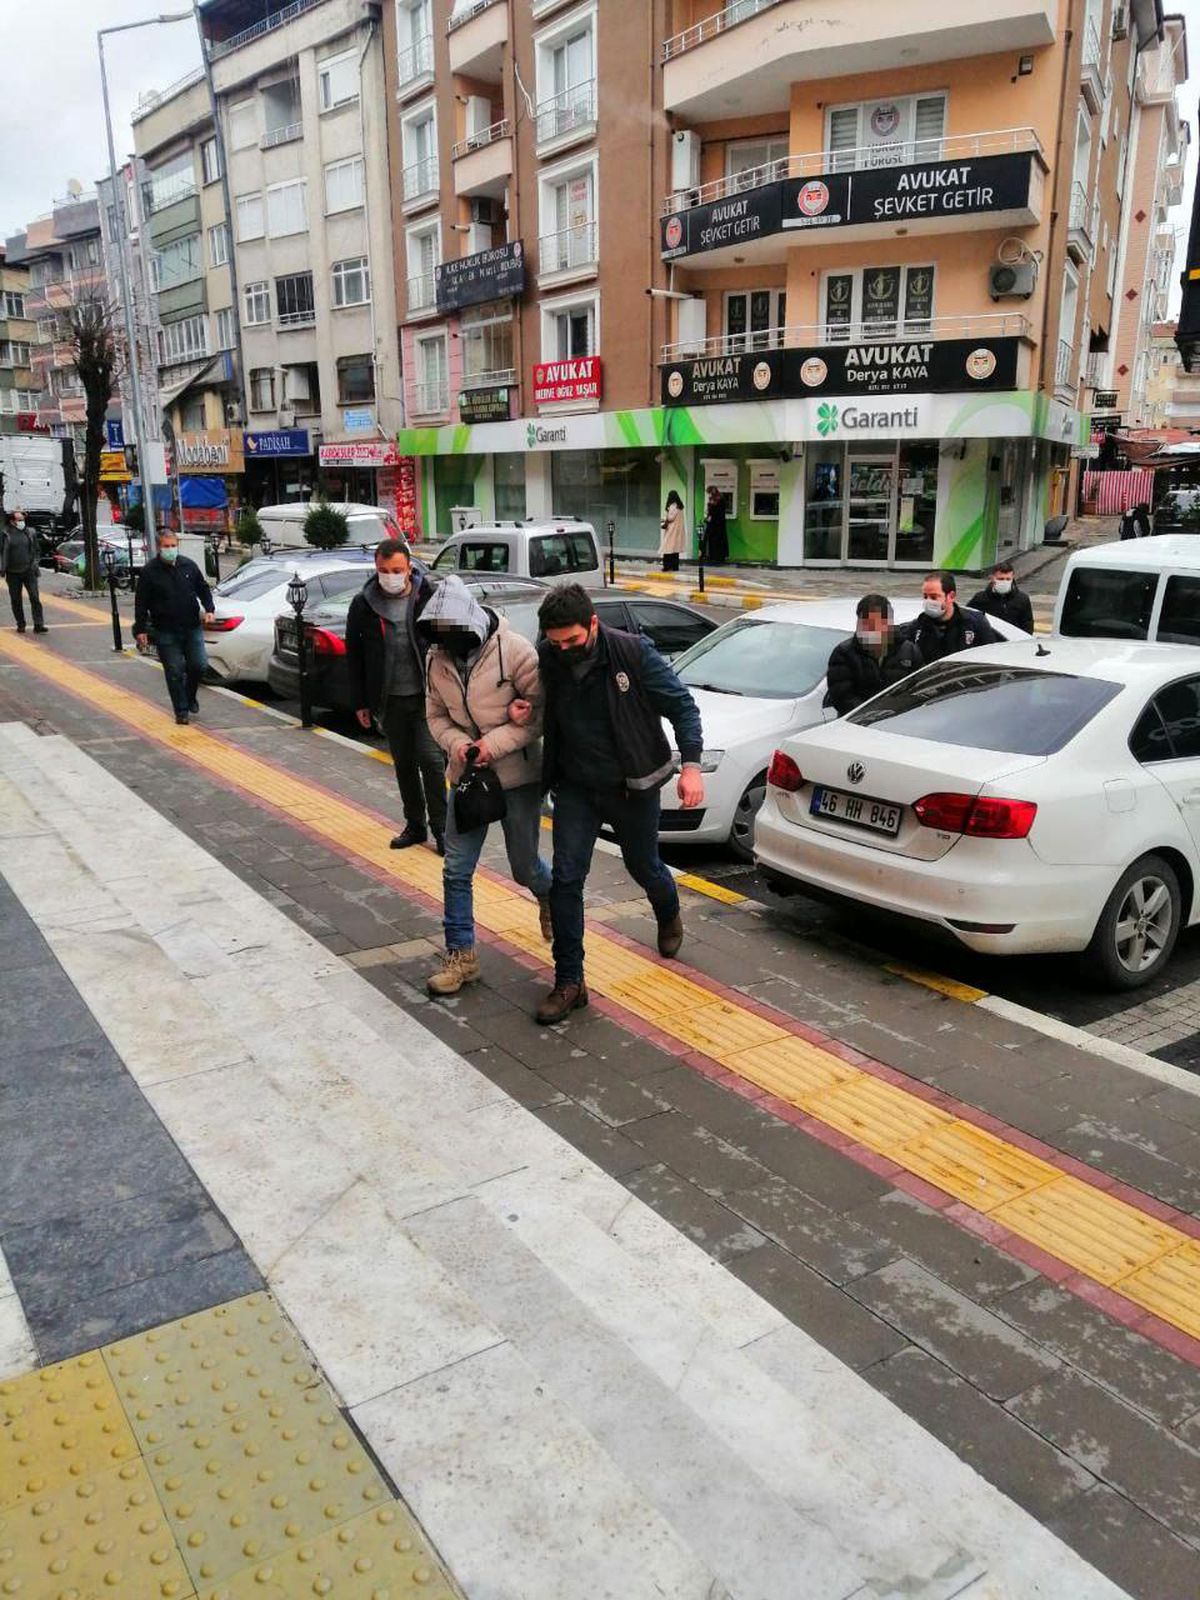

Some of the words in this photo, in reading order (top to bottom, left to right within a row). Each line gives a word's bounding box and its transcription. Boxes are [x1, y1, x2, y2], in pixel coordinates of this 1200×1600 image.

[897, 167, 971, 191] AVUKAT
[711, 200, 748, 223] AVUKAT
[874, 193, 938, 219] ŞEVKET
[942, 186, 993, 209] GETİR
[844, 343, 934, 367] AVUKAT
[546, 360, 593, 383] AVUKAT
[692, 357, 741, 378] AVUKAT
[847, 369, 888, 383] Derya
[892, 365, 928, 379] KAYA
[693, 381, 715, 393] Derya
[716, 377, 739, 390] KAYA
[841, 406, 918, 429] Garanti
[535, 425, 566, 442] Garanti
[821, 792, 838, 813] 46
[870, 805, 897, 829] 846
